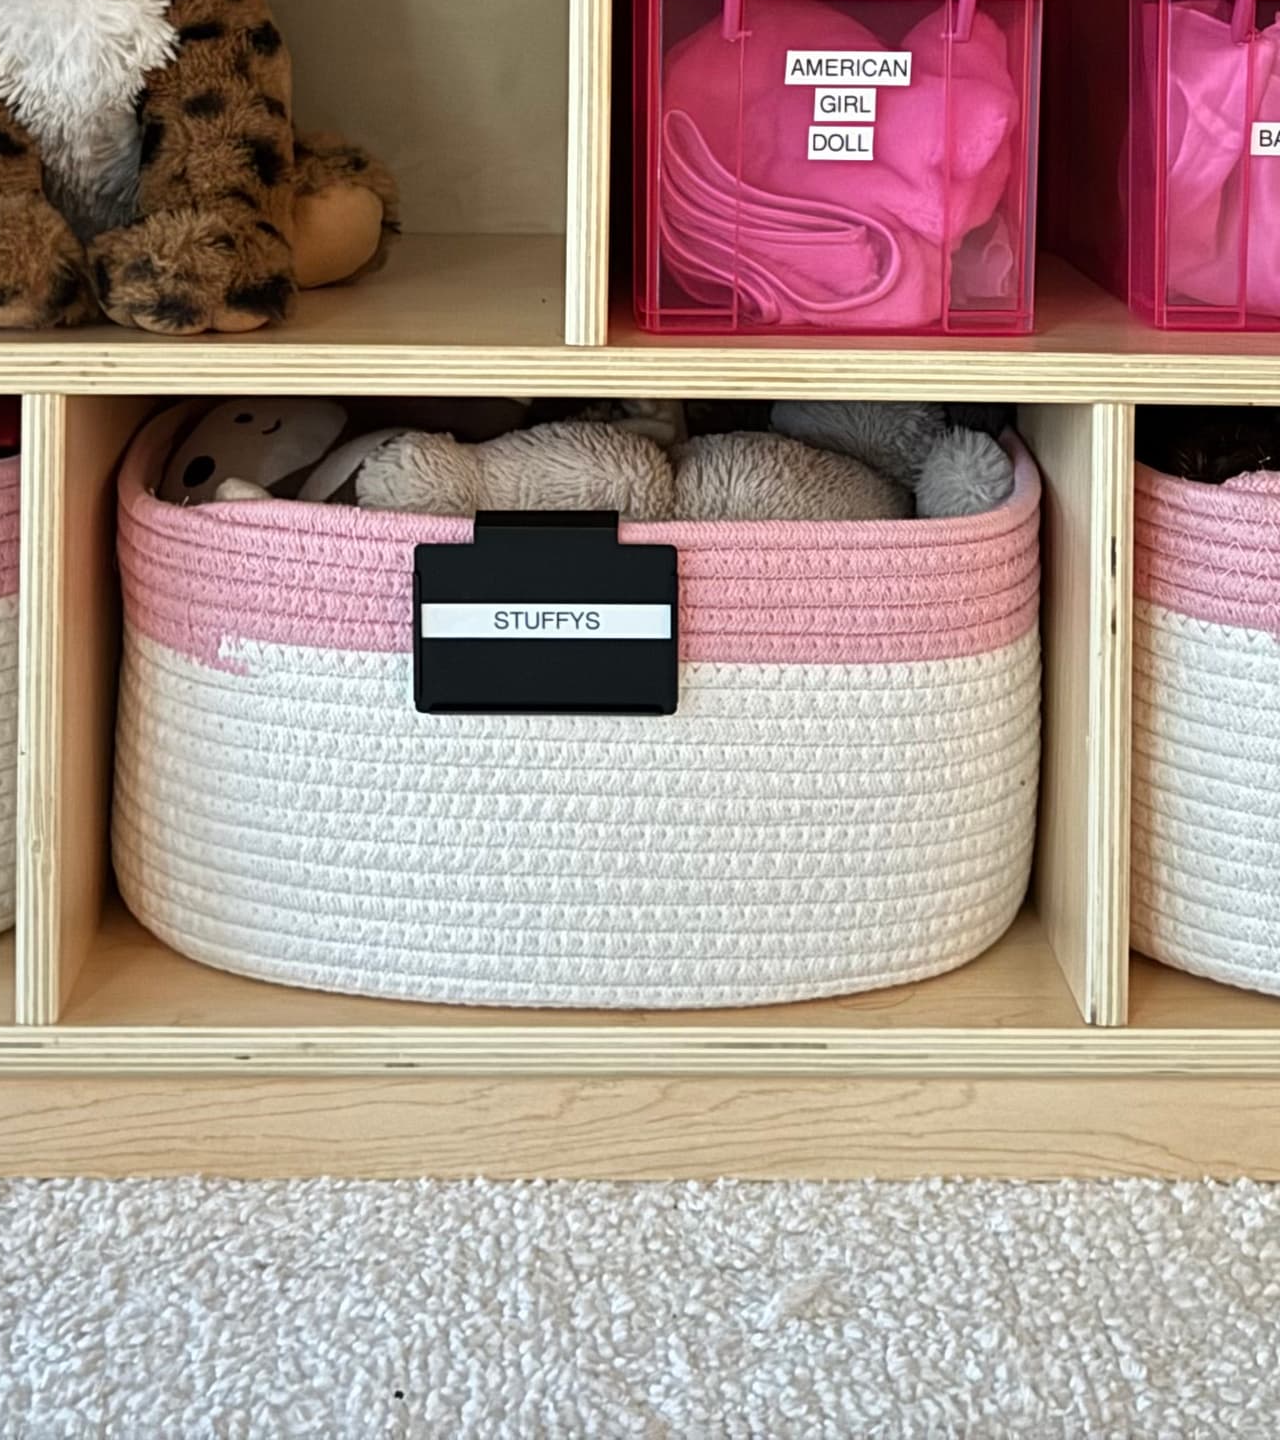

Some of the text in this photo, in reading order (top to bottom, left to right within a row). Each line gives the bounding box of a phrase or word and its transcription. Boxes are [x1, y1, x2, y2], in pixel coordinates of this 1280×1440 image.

[791, 59, 908, 77] AMERICAN
[820, 95, 871, 113] GIRL
[812, 134, 869, 152] DOLL
[494, 611, 601, 630] STUFFYS
